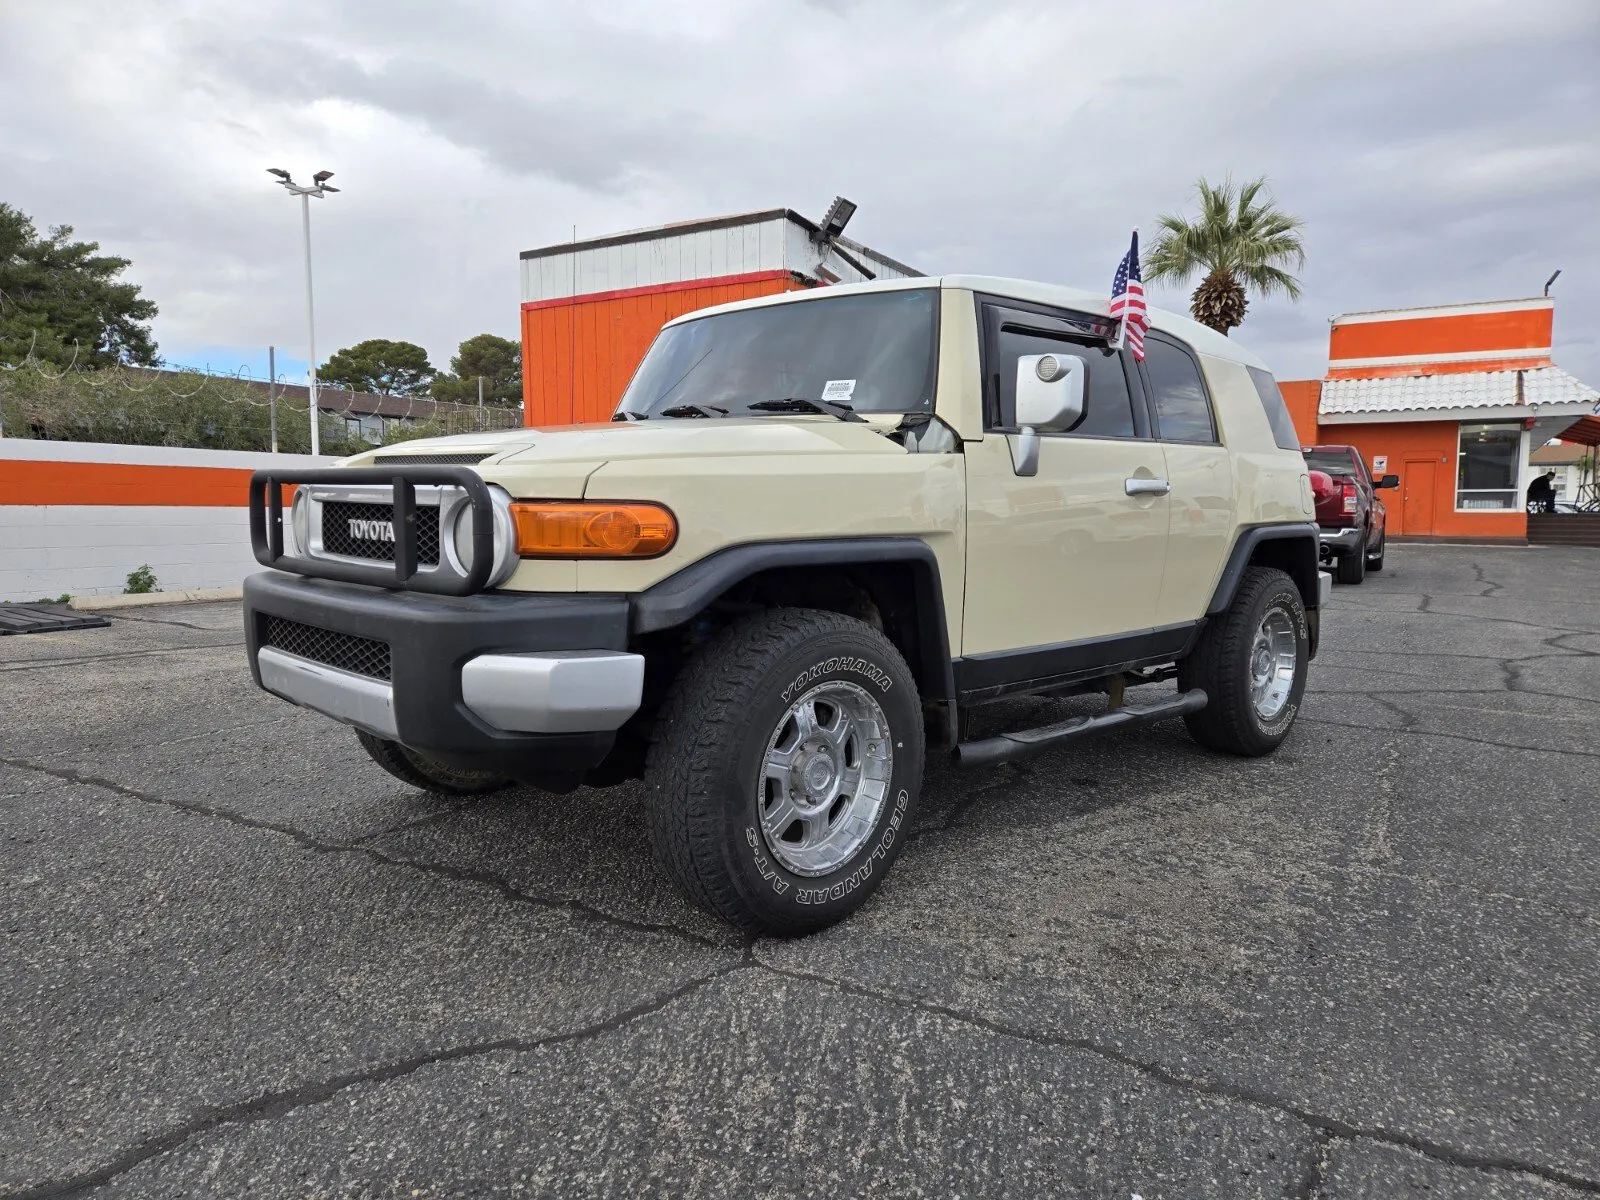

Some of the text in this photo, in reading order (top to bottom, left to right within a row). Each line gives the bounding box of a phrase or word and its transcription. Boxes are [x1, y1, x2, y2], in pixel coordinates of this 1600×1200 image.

[348, 519, 396, 542] TOYOTA
[781, 656, 893, 703] YOKOHAMA
[796, 789, 909, 905] GEOLANDAR
